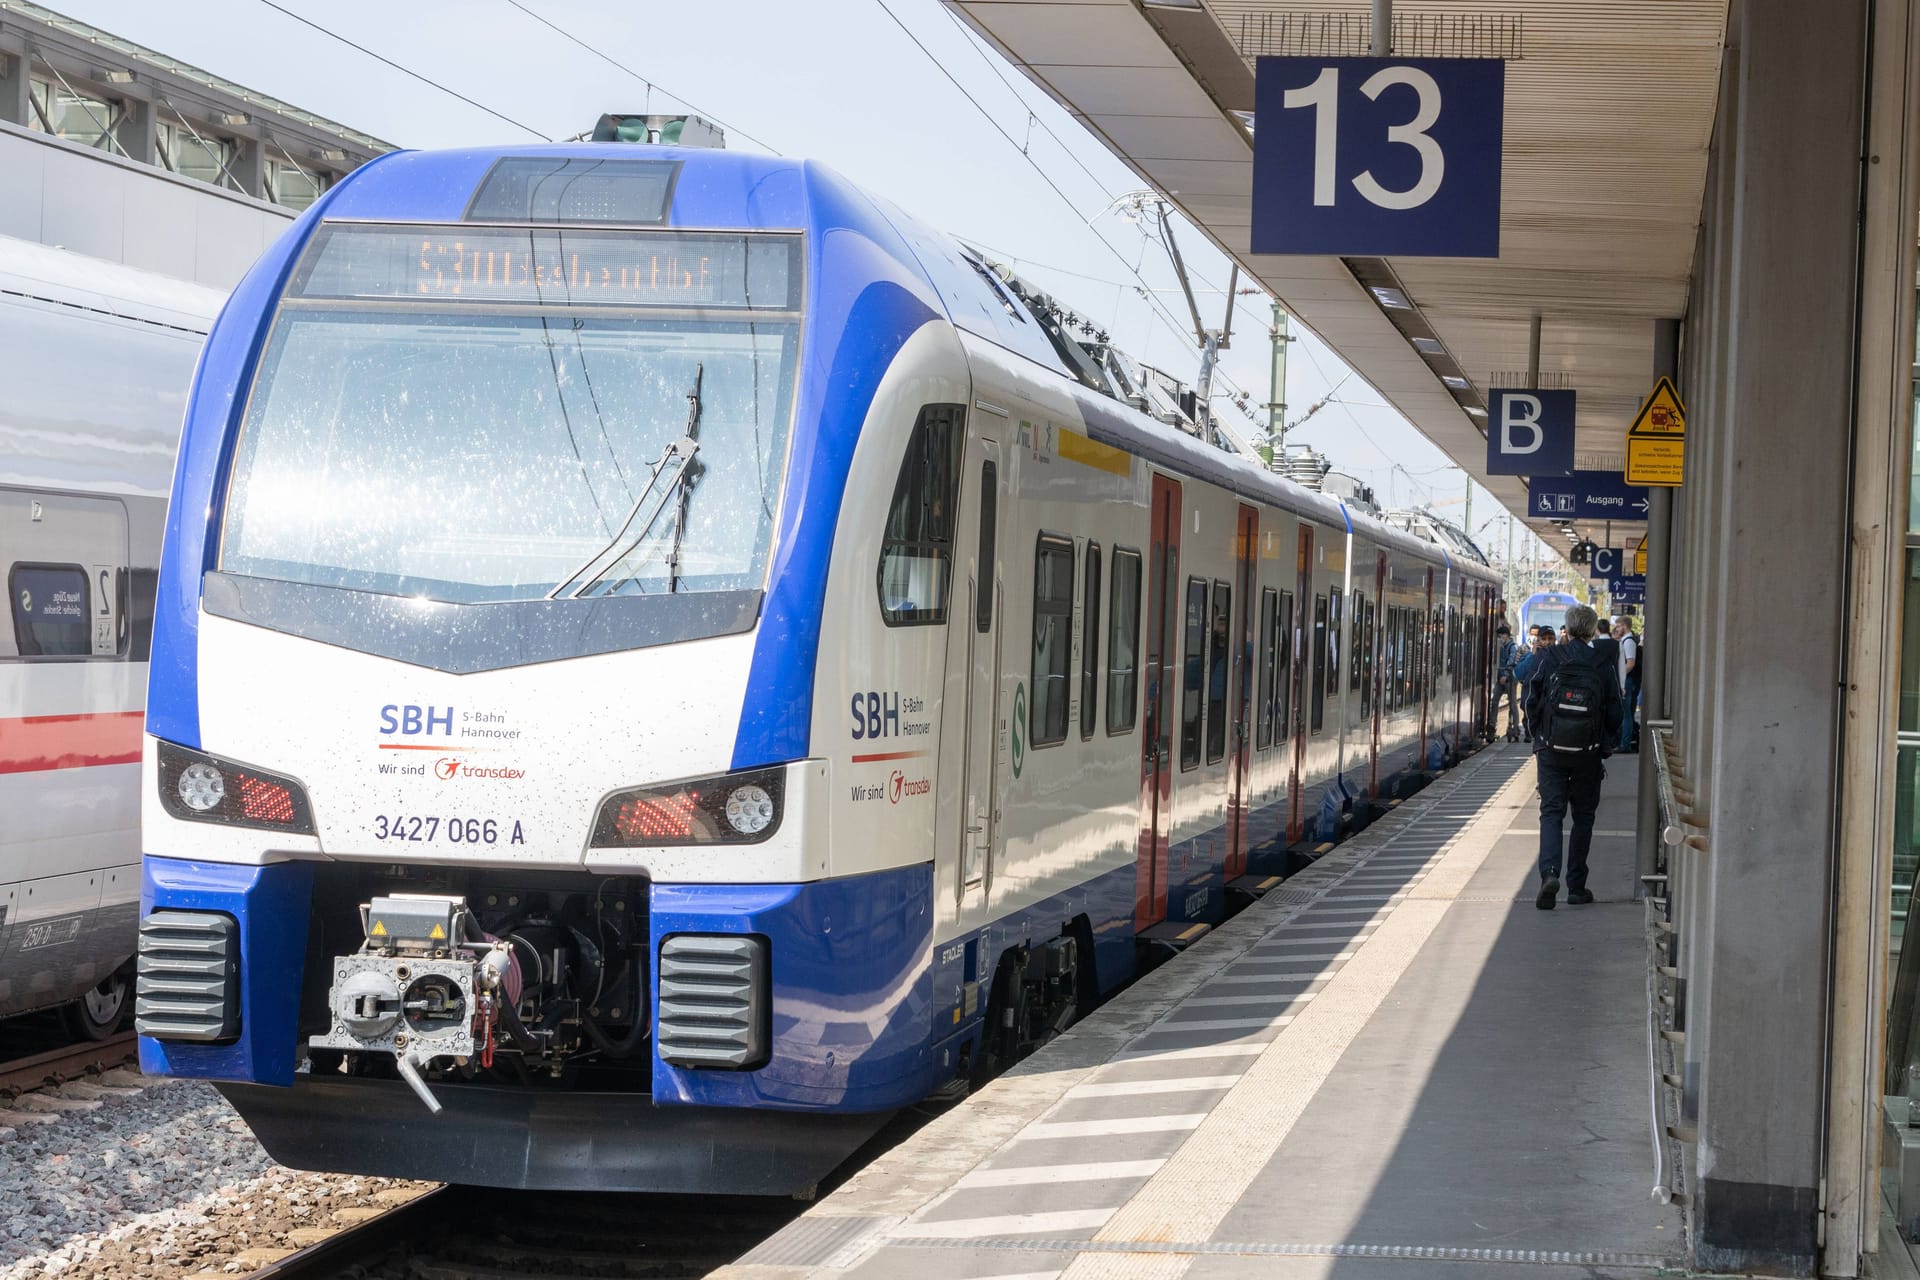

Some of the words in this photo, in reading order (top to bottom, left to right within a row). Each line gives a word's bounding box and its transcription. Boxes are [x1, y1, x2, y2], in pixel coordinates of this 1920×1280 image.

[1283, 66, 1445, 210] 13
[1500, 393, 1544, 454] B
[1586, 495, 1624, 506] Ausgang
[1595, 548, 1613, 573] C
[903, 696, 924, 713] S-Bahn
[379, 704, 454, 736] SBH
[462, 711, 505, 724] S-Bahn
[851, 691, 899, 740] SBH
[461, 727, 521, 739] Hannover
[903, 721, 931, 737] Hannover
[378, 764, 398, 775] Wir
[401, 764, 425, 775] sind
[462, 765, 525, 779] transdev
[851, 786, 866, 801] Wir
[868, 783, 885, 800] sind
[904, 777, 931, 797] transdev
[375, 815, 440, 842] 3427
[448, 818, 497, 844] 066
[511, 820, 524, 845] A
